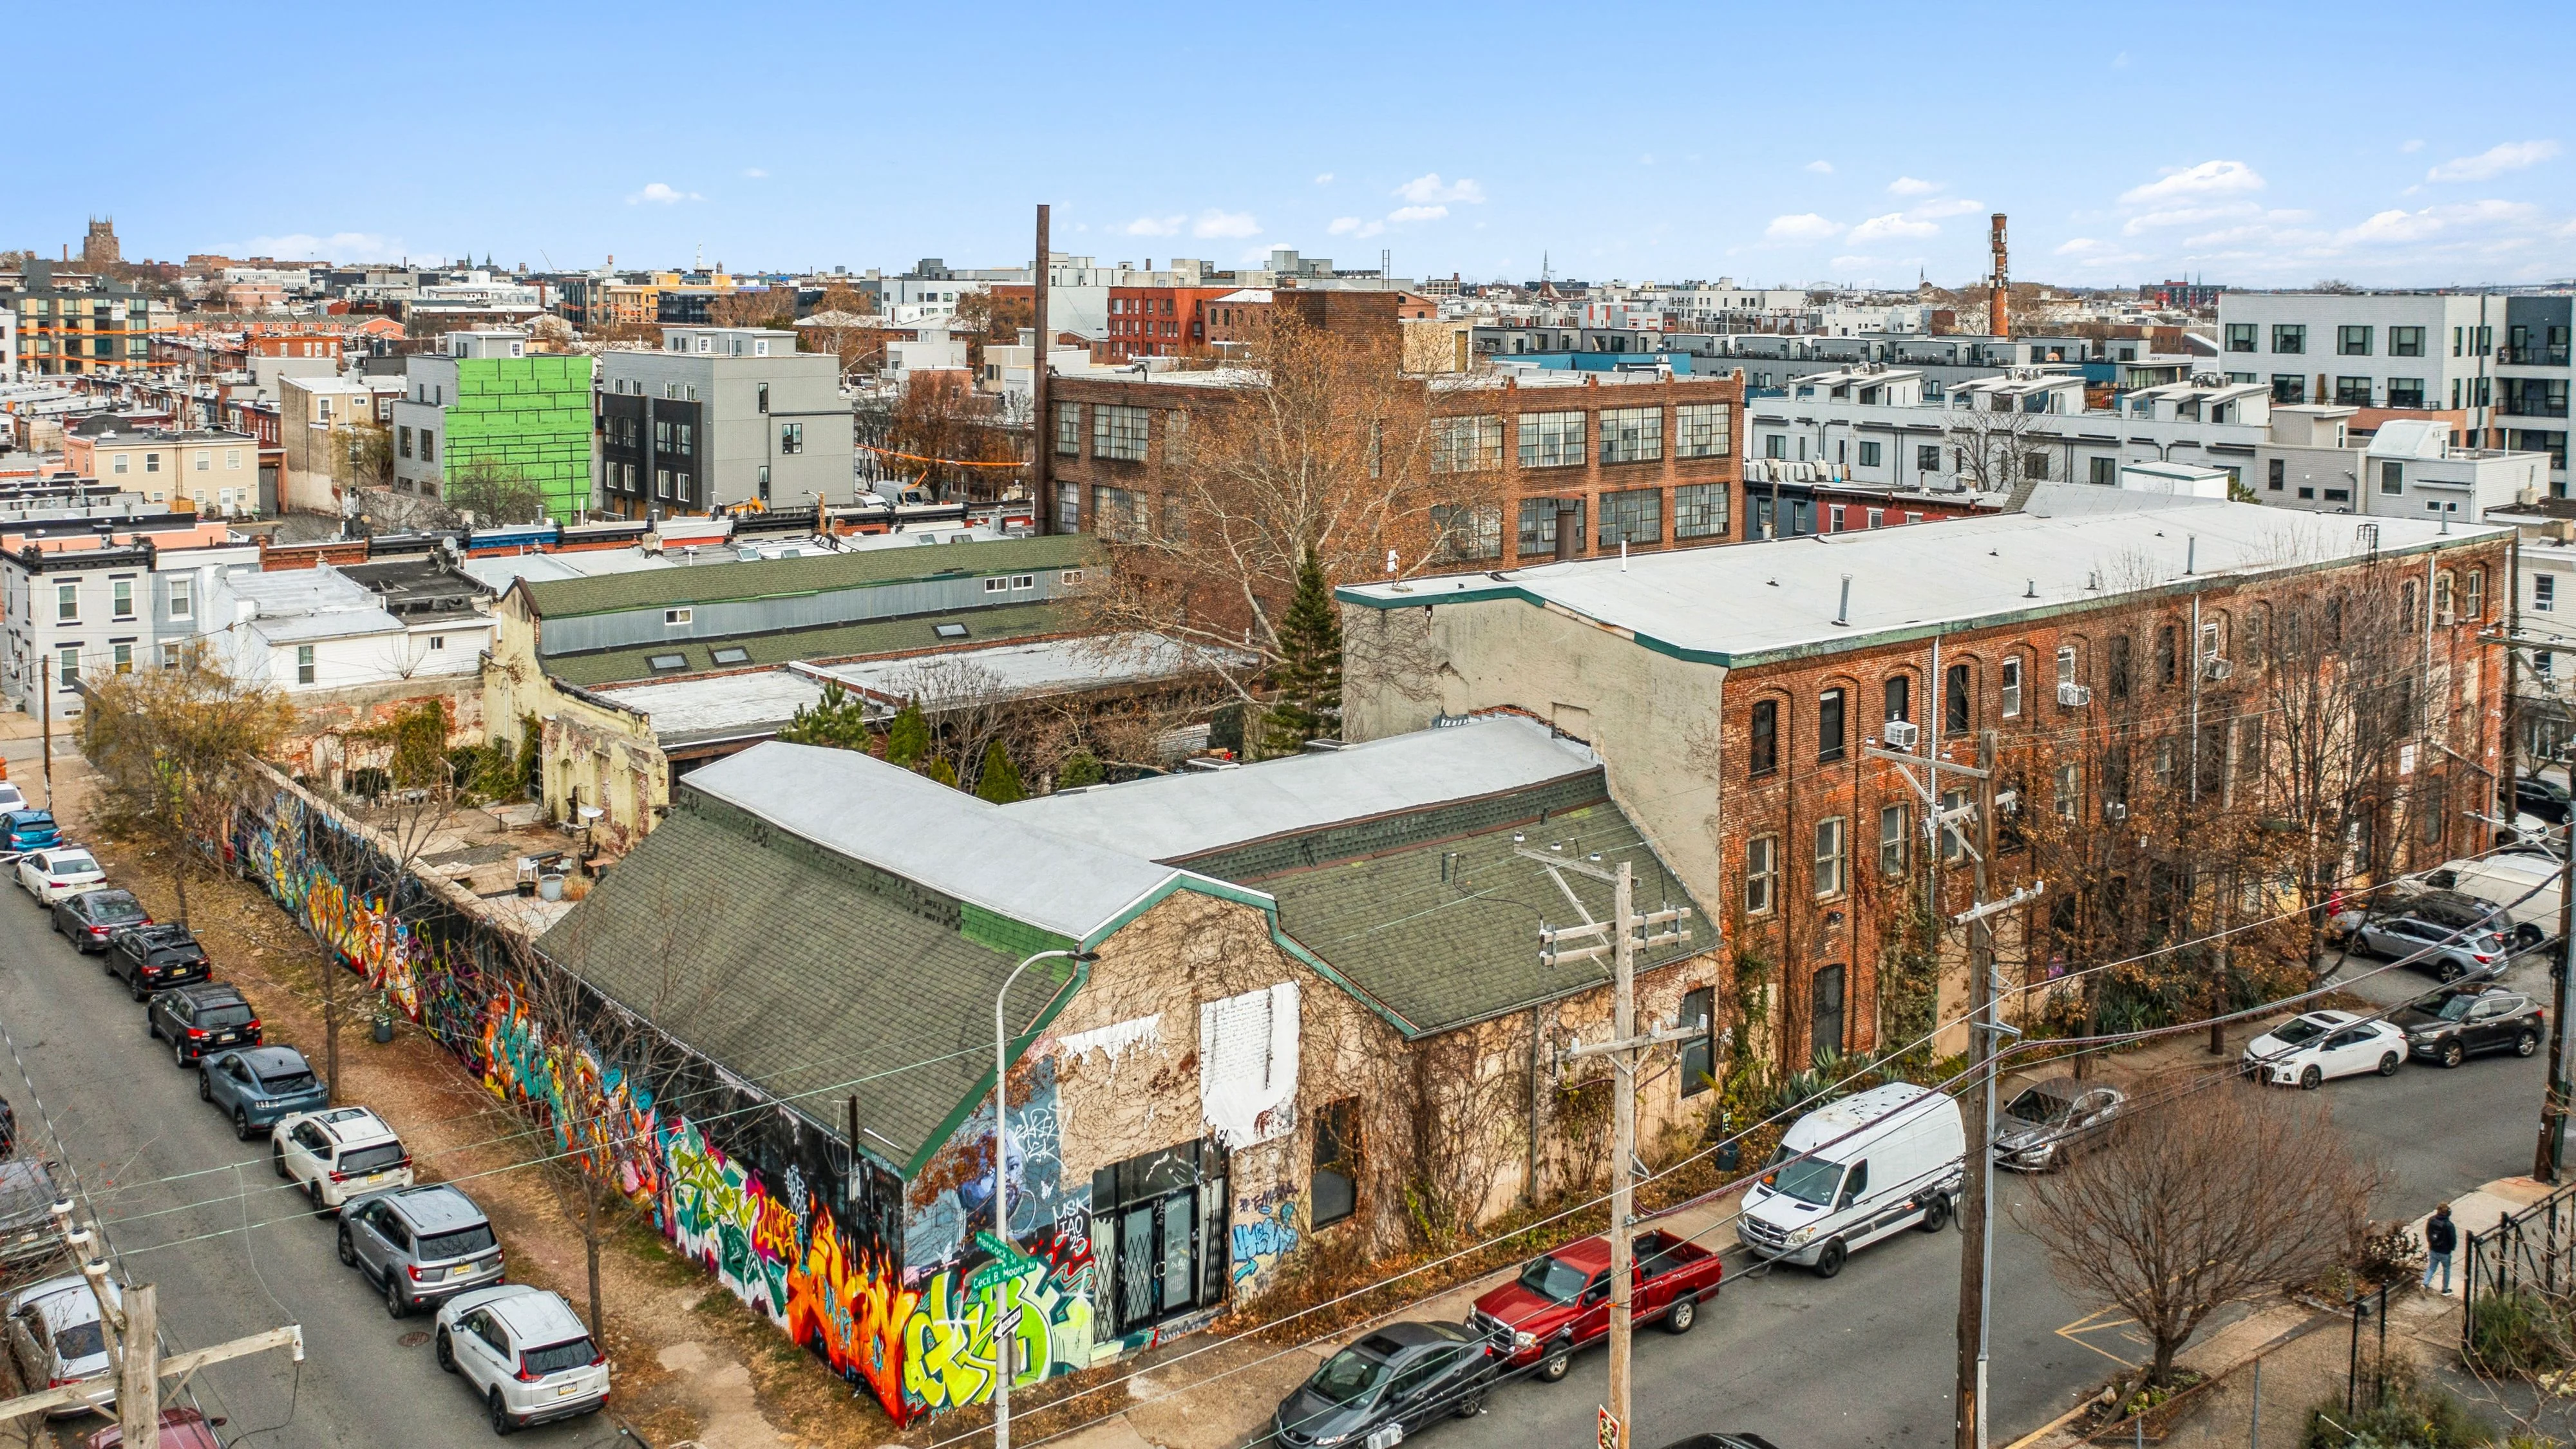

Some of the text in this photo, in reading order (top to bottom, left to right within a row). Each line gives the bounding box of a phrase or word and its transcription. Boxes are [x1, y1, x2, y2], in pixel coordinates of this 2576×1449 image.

[977, 1233, 1017, 1266] Hancock St
[973, 1262, 1036, 1289] Cecil B. Moore Av
[1001, 1311, 1019, 1331] ONE WAY
